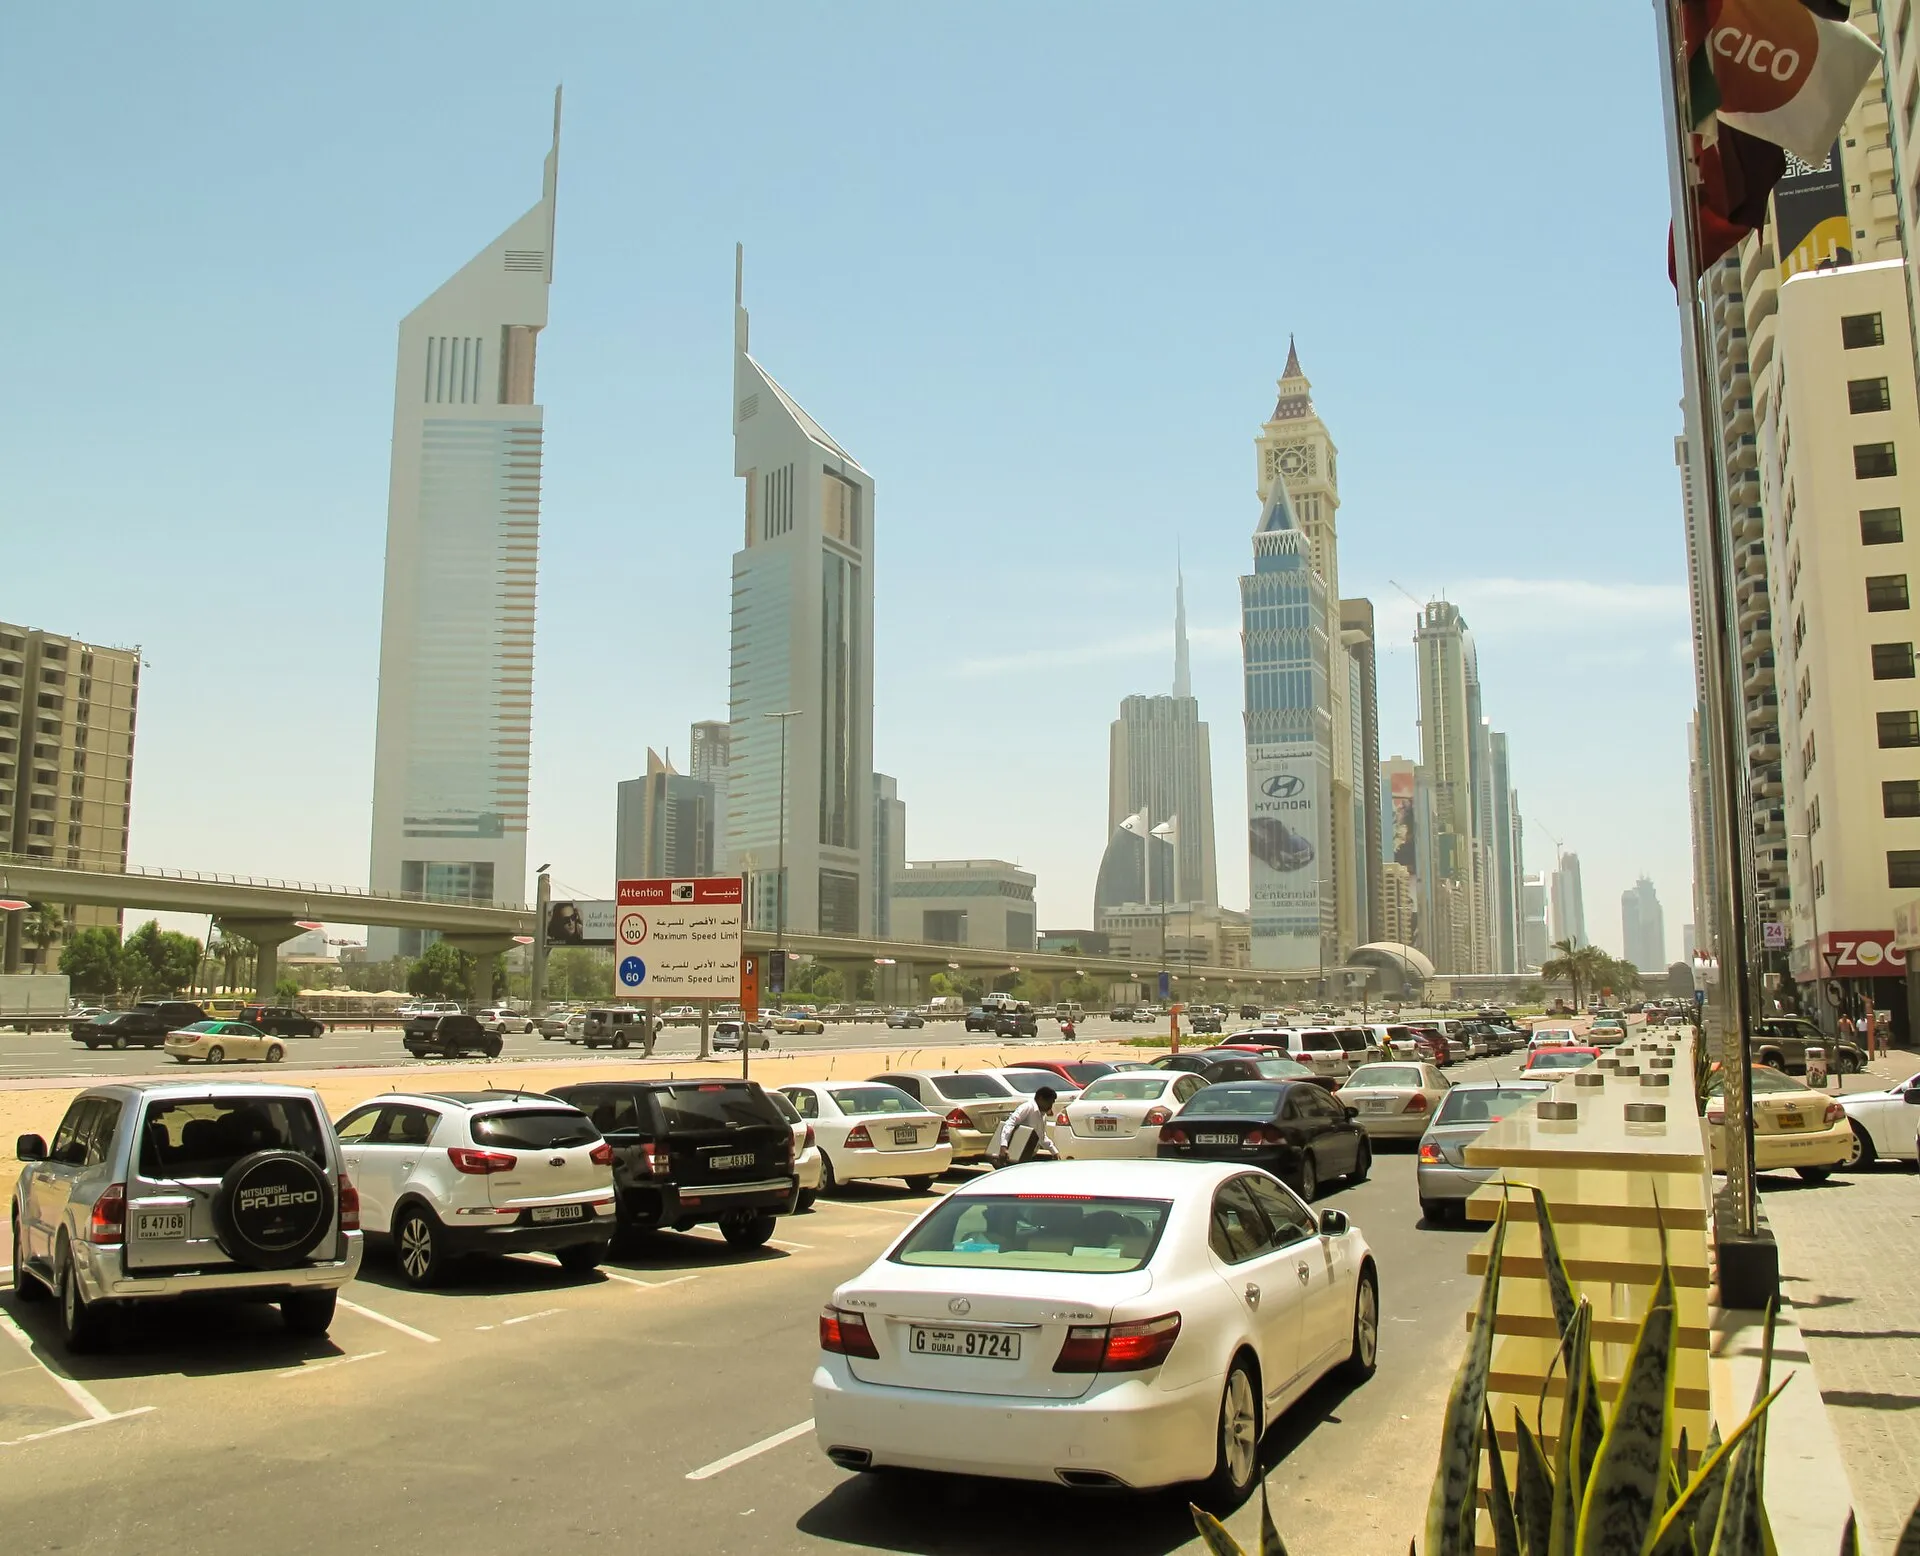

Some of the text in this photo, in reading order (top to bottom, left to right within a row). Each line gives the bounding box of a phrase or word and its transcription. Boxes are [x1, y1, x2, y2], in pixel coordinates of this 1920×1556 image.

[1255, 801, 1311, 811] HYUNDAI
[620, 887, 664, 898] Attention
[1254, 890, 1317, 900] Centennial
[656, 918, 685, 928] للسرعة
[720, 918, 739, 926] الحد
[625, 930, 641, 939] 100
[653, 931, 739, 942] Maximum Speed Limit
[1767, 926, 1782, 937] 24
[660, 961, 689, 971] للسرعة
[719, 961, 738, 969] الحد
[746, 960, 752, 975] P
[626, 973, 638, 982] 60
[651, 974, 735, 984] Minimum Speed Limit
[240, 1184, 288, 1199] MITSUBISHI
[241, 1191, 317, 1211] PAJERO
[555, 1206, 580, 1218] 78910
[141, 1216, 183, 1229] B 47168
[916, 1330, 1012, 1357] G DUBAI 9724
